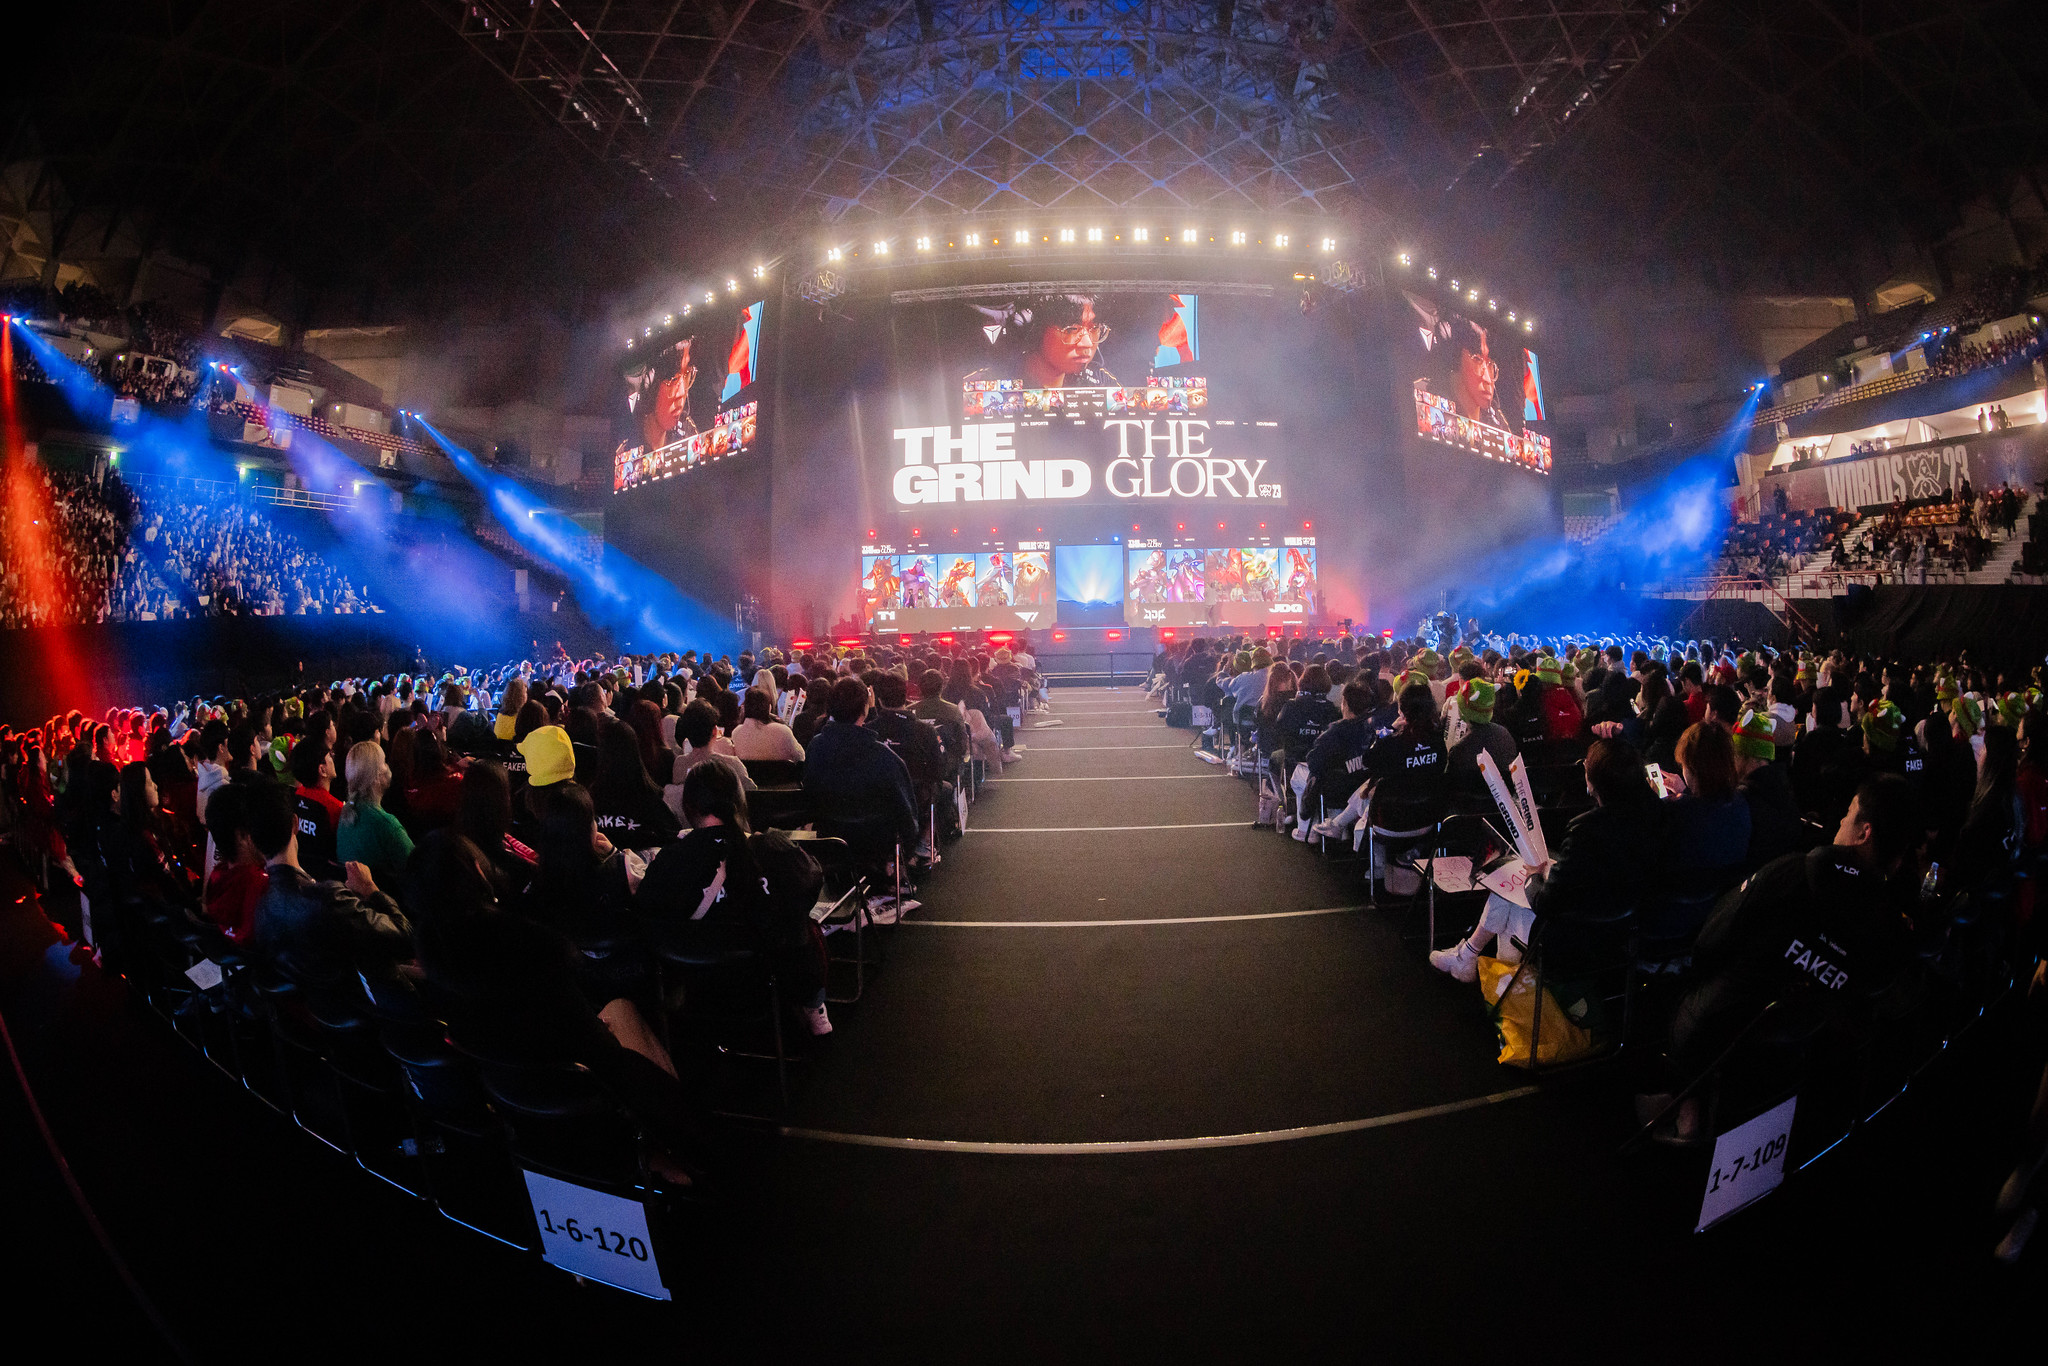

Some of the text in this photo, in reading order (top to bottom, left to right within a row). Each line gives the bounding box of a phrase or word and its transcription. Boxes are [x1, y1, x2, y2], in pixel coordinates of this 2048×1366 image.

[893, 422, 1016, 466] THE
[1103, 419, 1213, 458] THE
[892, 459, 1092, 505] GRIND
[1105, 458, 1267, 498] GLORY
[1824, 444, 1972, 513] WORLDS 23
[877, 610, 896, 621] T1
[1268, 603, 1304, 613] JDG
[1406, 752, 1438, 769] FAKER
[298, 817, 317, 837] KER
[1498, 801, 1520, 840] GRIND
[1520, 797, 1535, 832] GRIND
[1784, 938, 1849, 990] FAKER
[1709, 1133, 1787, 1194] 1-7-109
[540, 1209, 649, 1262] 1-6-120
